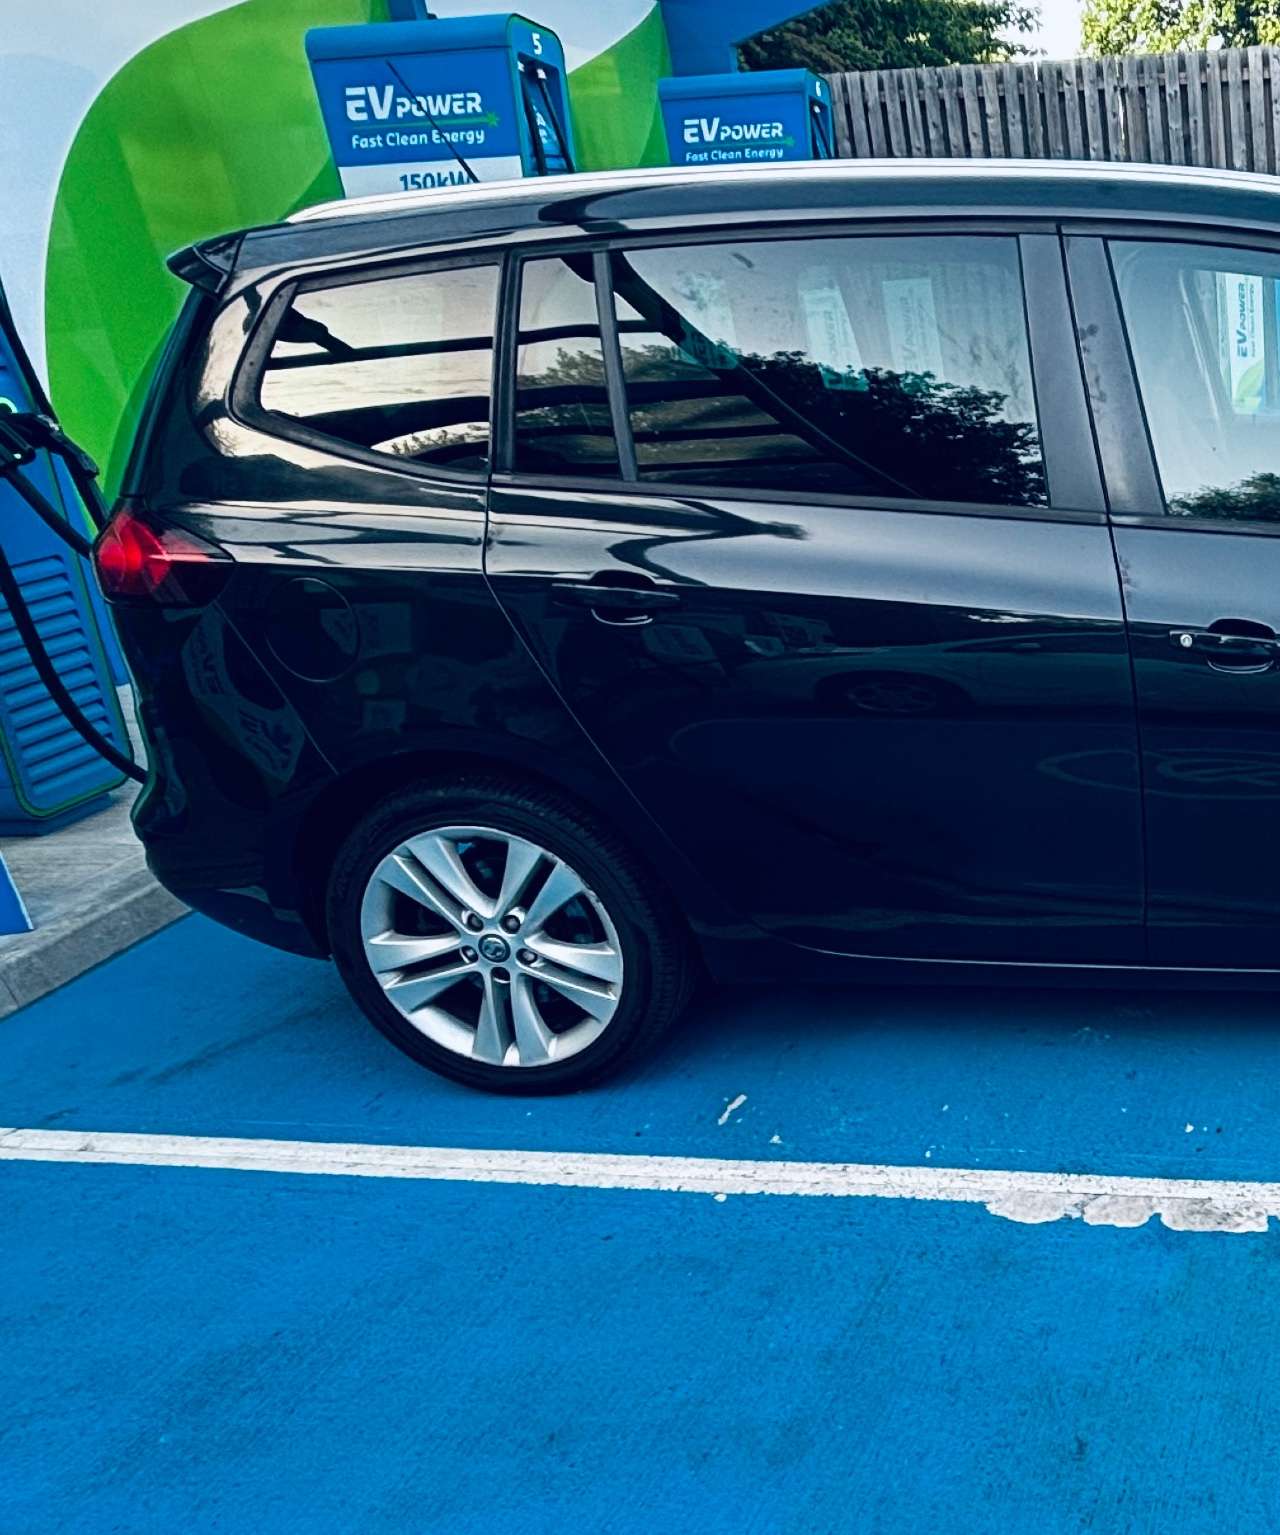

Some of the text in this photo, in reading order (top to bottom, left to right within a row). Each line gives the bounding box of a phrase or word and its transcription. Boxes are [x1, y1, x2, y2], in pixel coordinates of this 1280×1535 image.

[531, 32, 543, 55] 5
[396, 92, 483, 118] POWER
[351, 129, 485, 149] Fast Clean Energy
[686, 148, 784, 162] Fast Clean Energy
